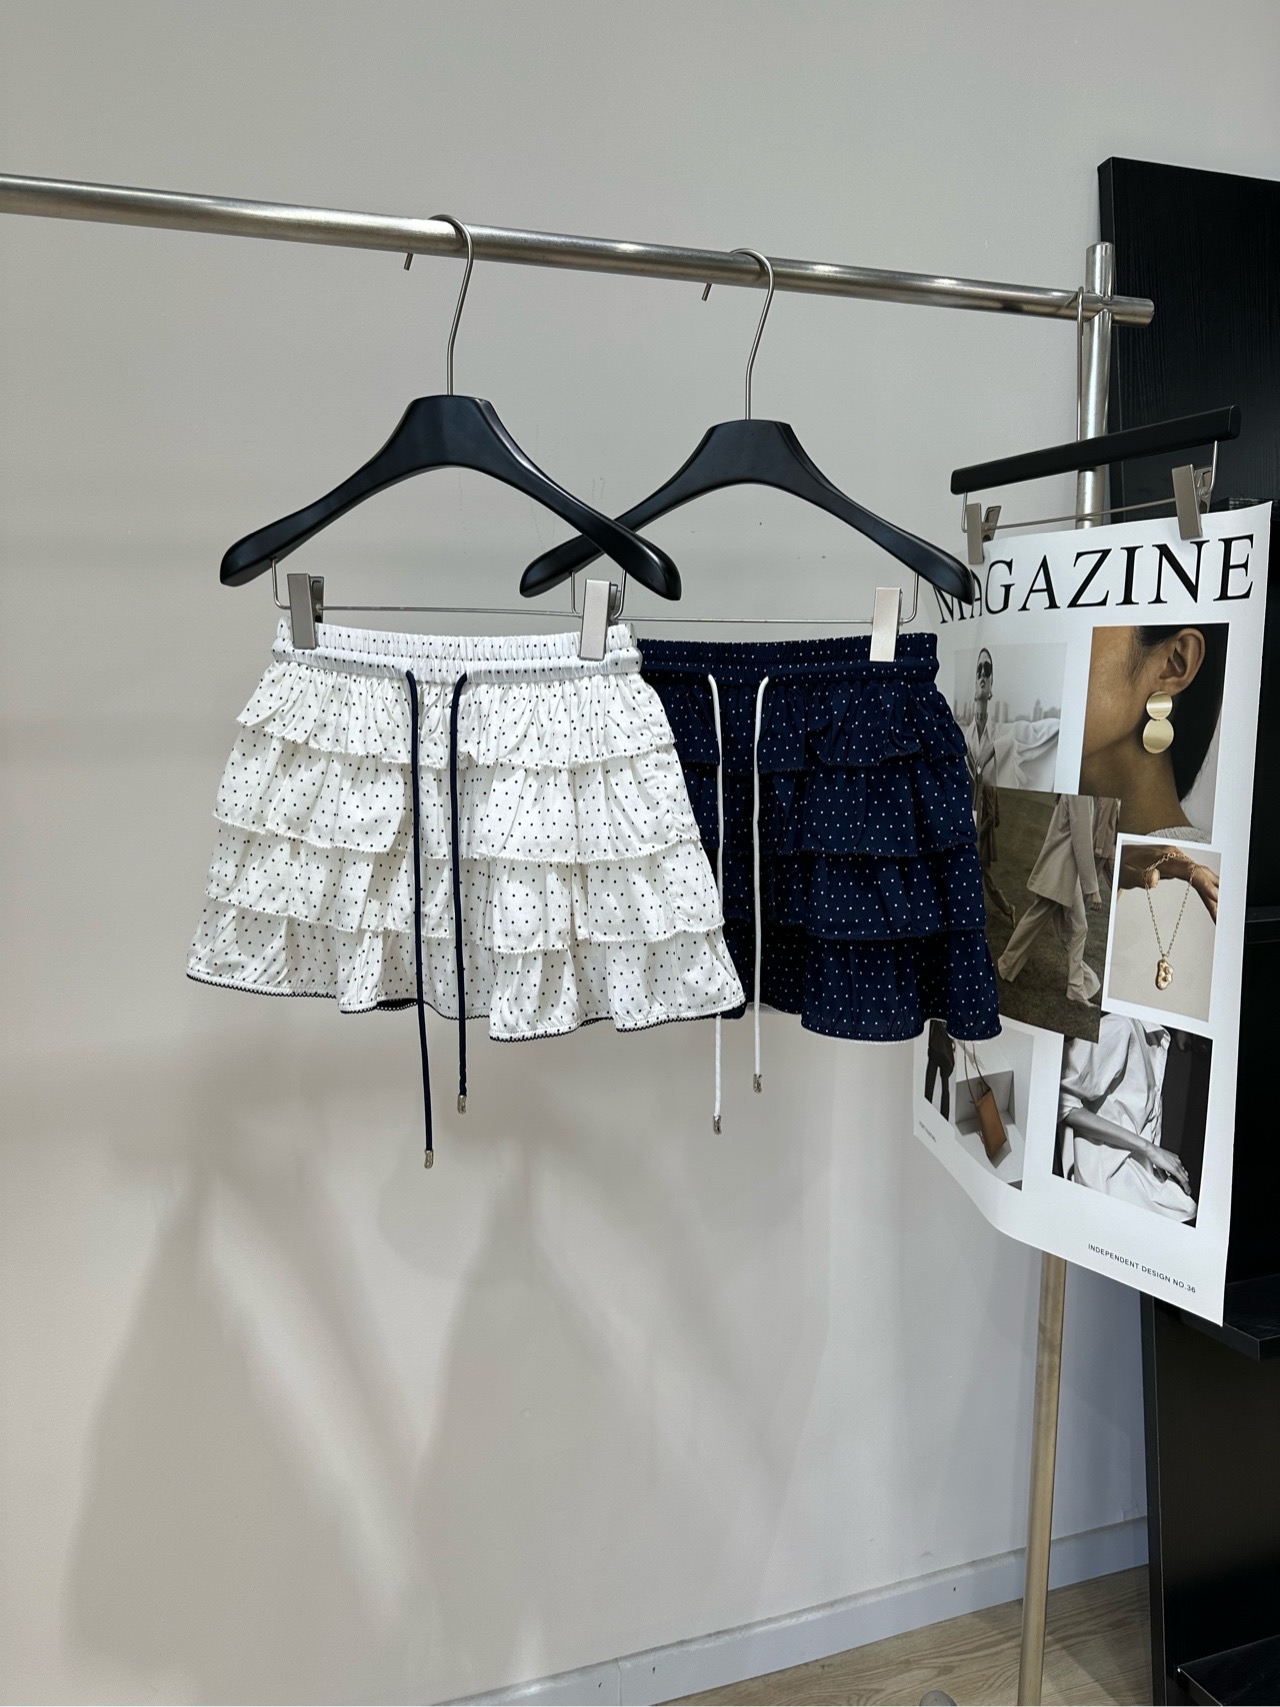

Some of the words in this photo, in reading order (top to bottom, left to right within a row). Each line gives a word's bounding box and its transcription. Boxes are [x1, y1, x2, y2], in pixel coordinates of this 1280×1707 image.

[1088, 1243, 1139, 1270] INDEPENDENT
[1141, 1265, 1171, 1283] DESIGN
[1172, 1278, 1196, 1293] NO.36
